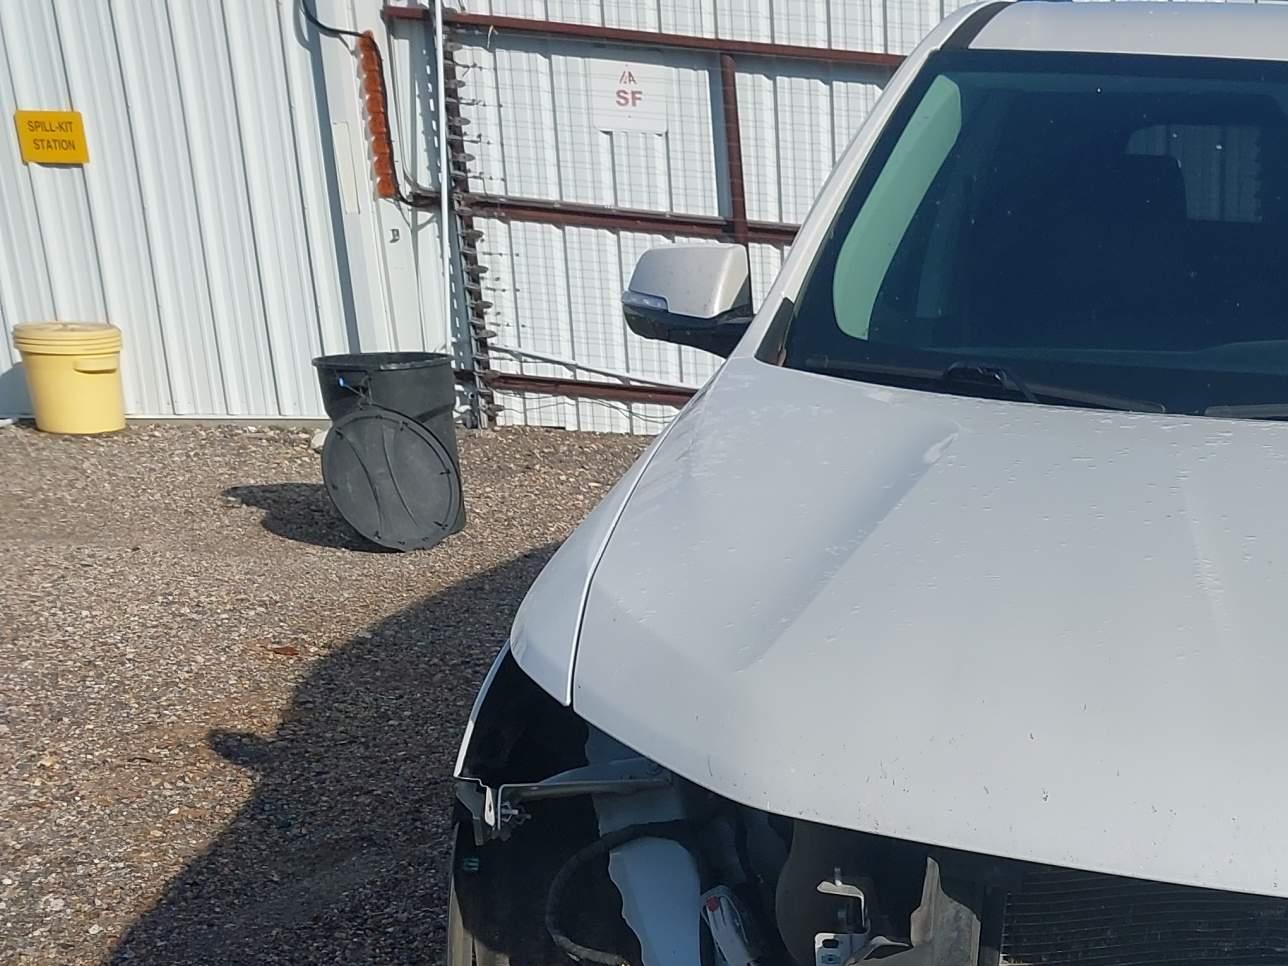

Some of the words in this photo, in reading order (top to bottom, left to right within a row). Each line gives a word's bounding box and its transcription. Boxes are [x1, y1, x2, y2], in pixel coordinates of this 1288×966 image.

[615, 89, 643, 107] SF
[26, 120, 73, 133] SPILL-KIT
[33, 139, 76, 151] STATION
